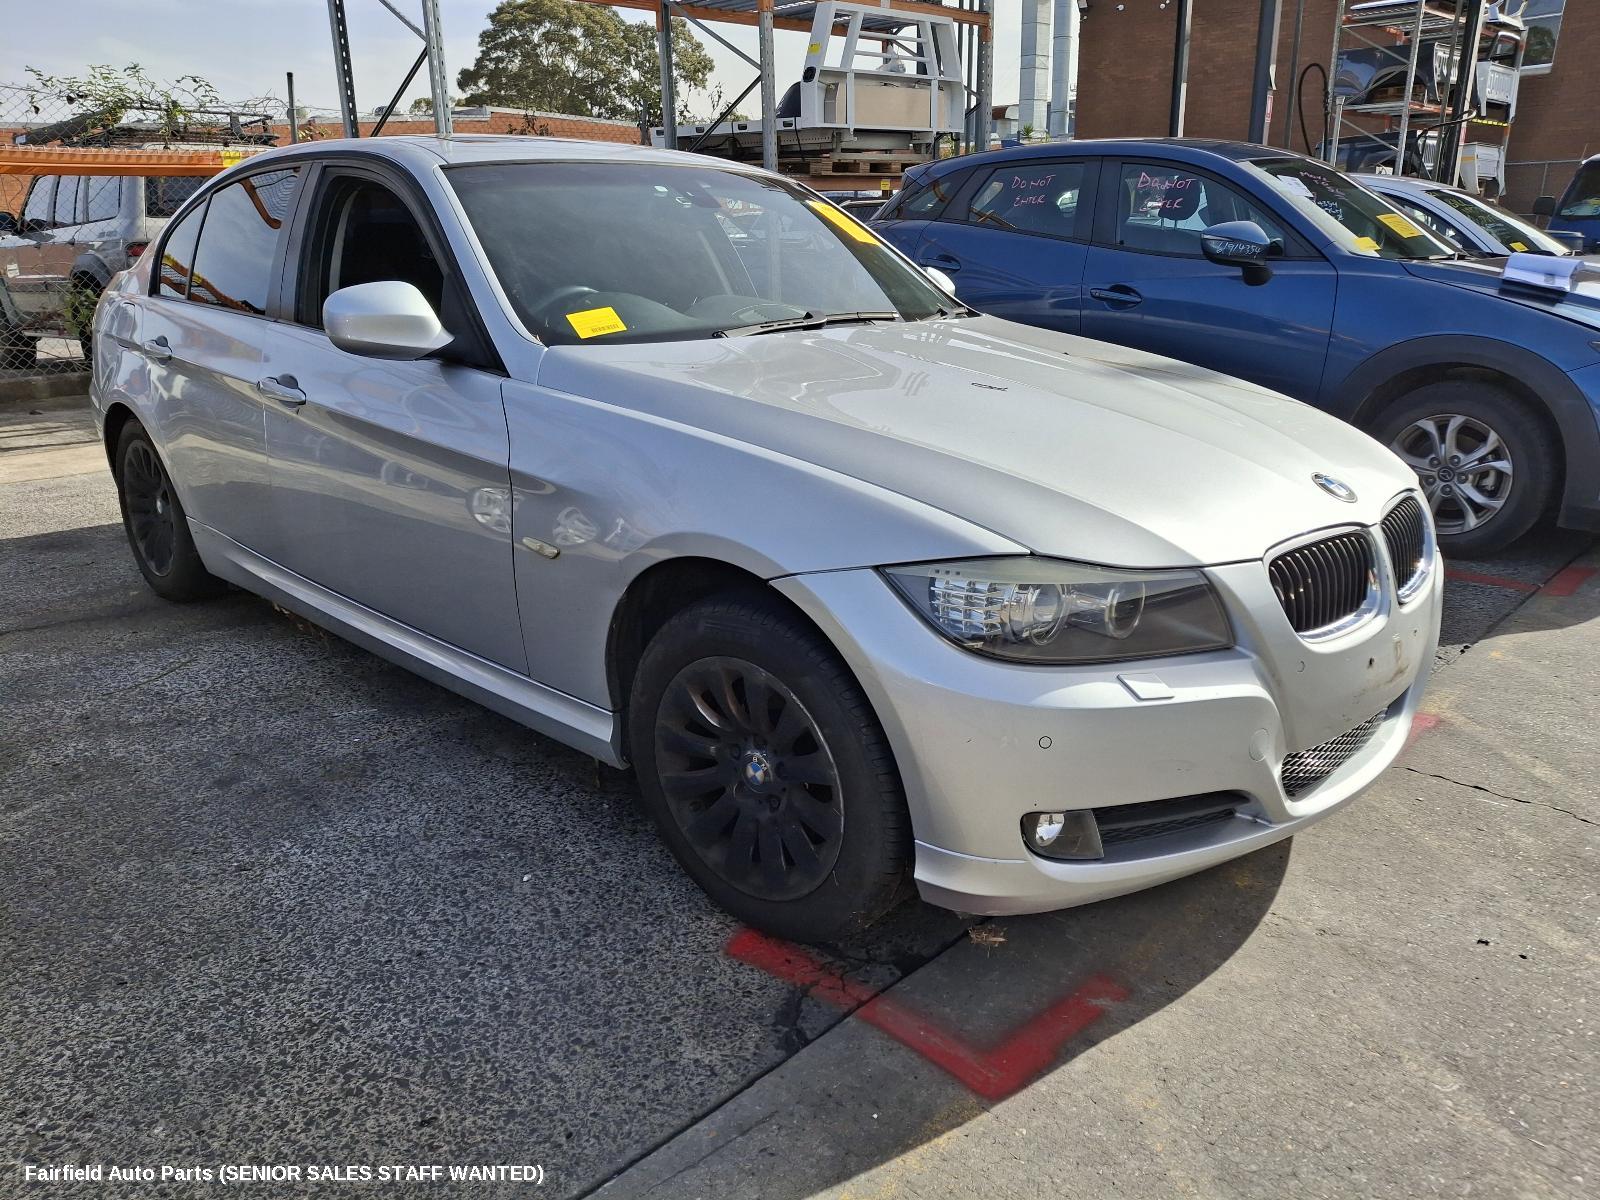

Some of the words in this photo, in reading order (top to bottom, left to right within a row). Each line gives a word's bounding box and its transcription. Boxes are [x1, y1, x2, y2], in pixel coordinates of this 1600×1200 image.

[1011, 175, 1027, 189] DO
[1029, 174, 1056, 190] NOT
[1013, 194, 1046, 207] ENTER
